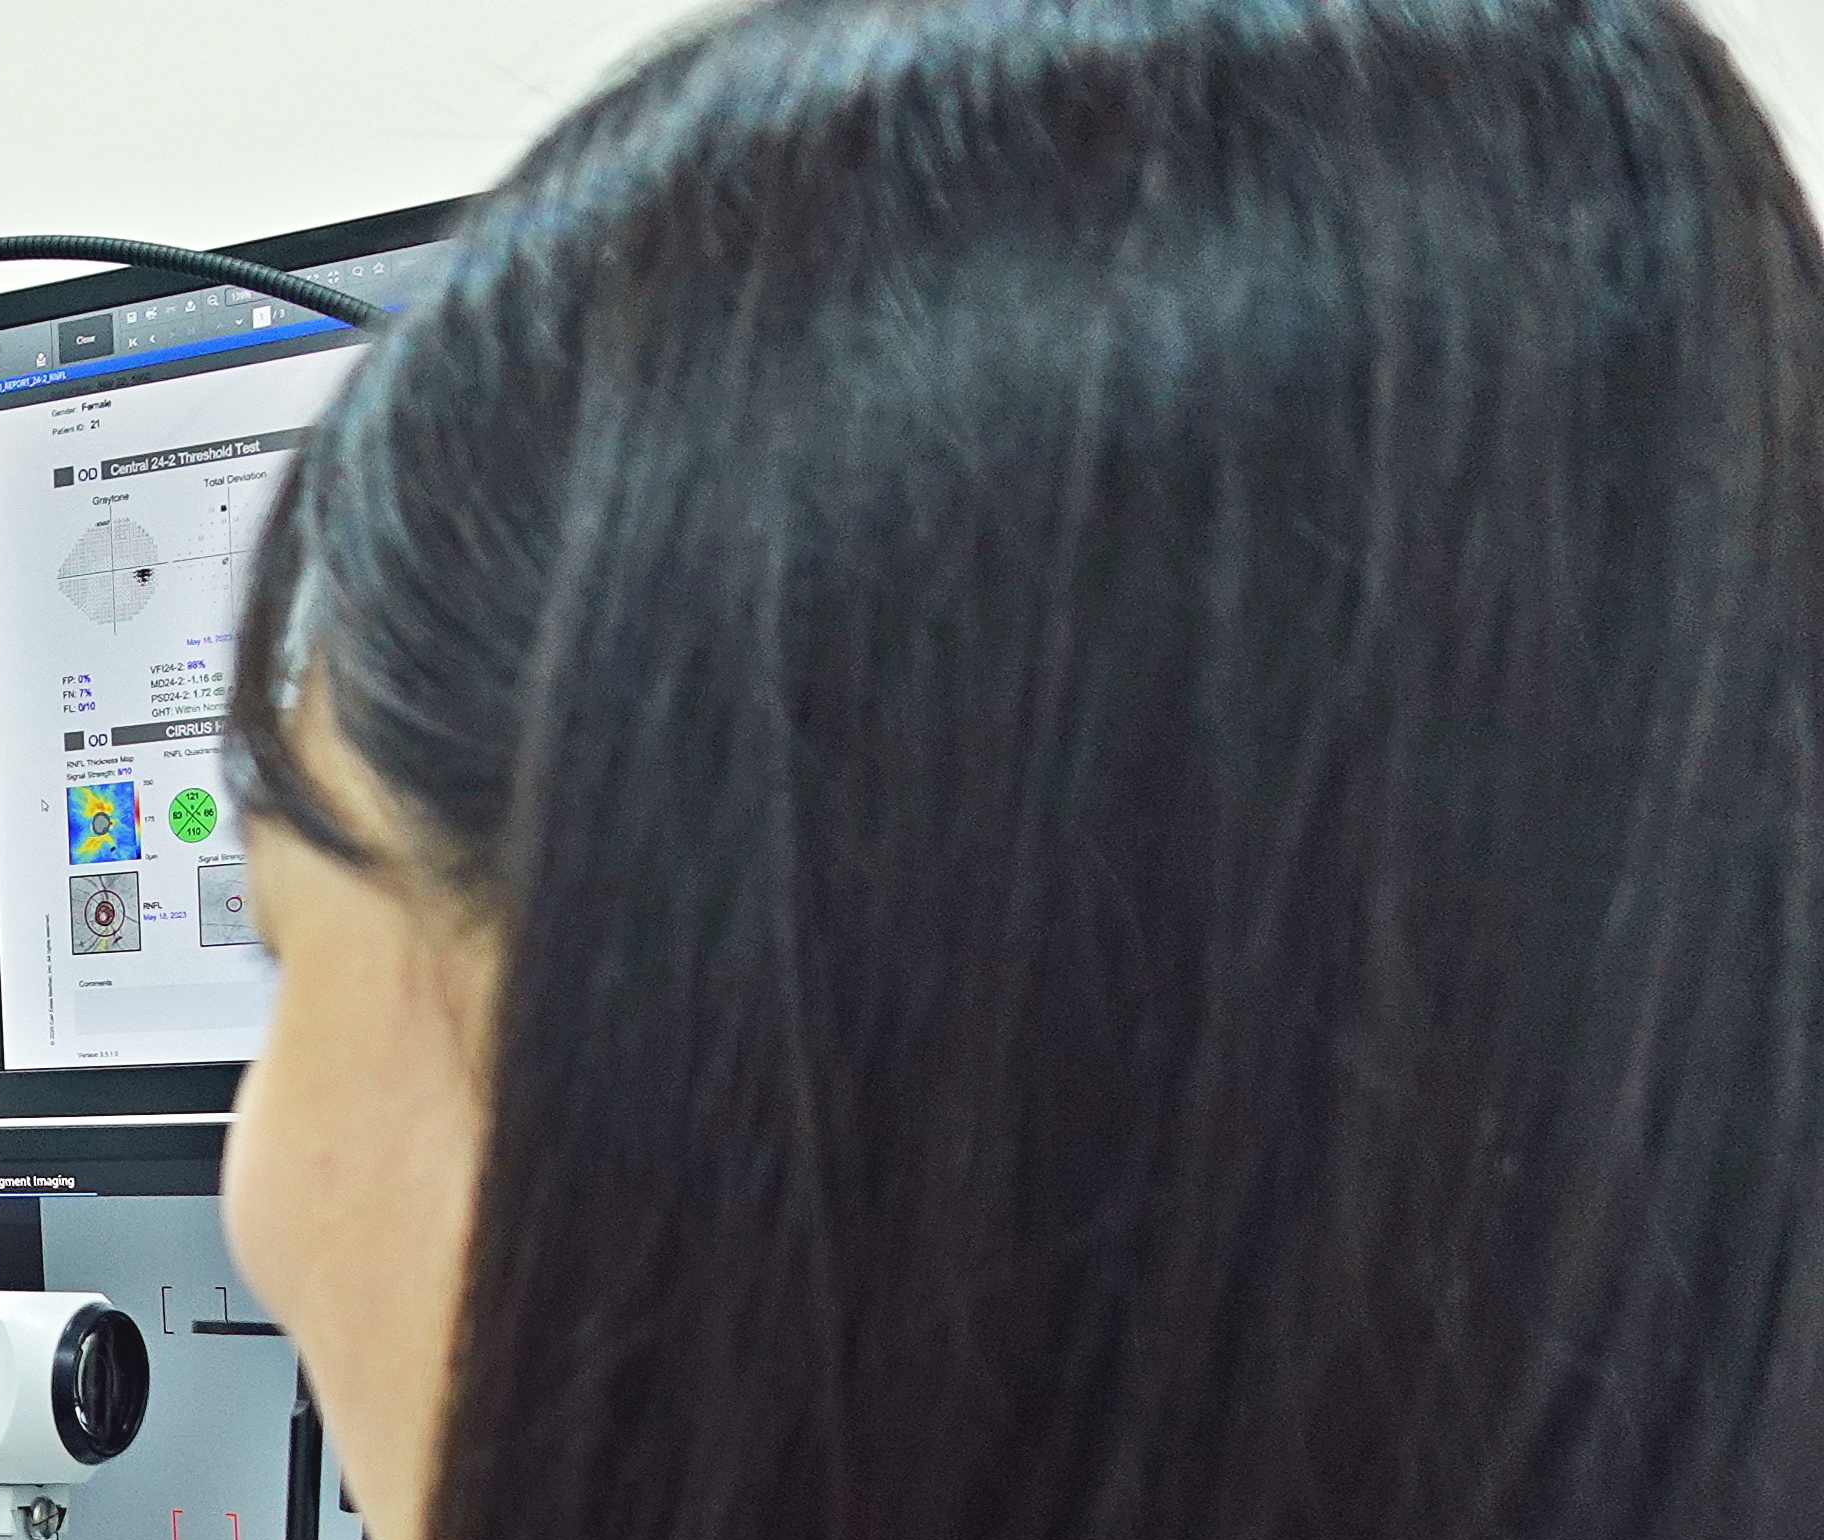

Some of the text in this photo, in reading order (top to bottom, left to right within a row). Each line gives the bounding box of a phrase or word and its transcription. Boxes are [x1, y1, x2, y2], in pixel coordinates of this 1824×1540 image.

[81, 399, 112, 412] Female
[90, 419, 100, 430] 21
[109, 440, 261, 477] Central 24-2 Threshold Test
[78, 466, 98, 482] OD
[204, 470, 267, 488] Total Deviation
[92, 492, 130, 507] Graytone
[165, 722, 213, 739] CIRRUS
[88, 733, 108, 748] OD
[186, 792, 199, 800] 121
[187, 827, 201, 836] 110
[33, 1174, 76, 1189] Imaging
